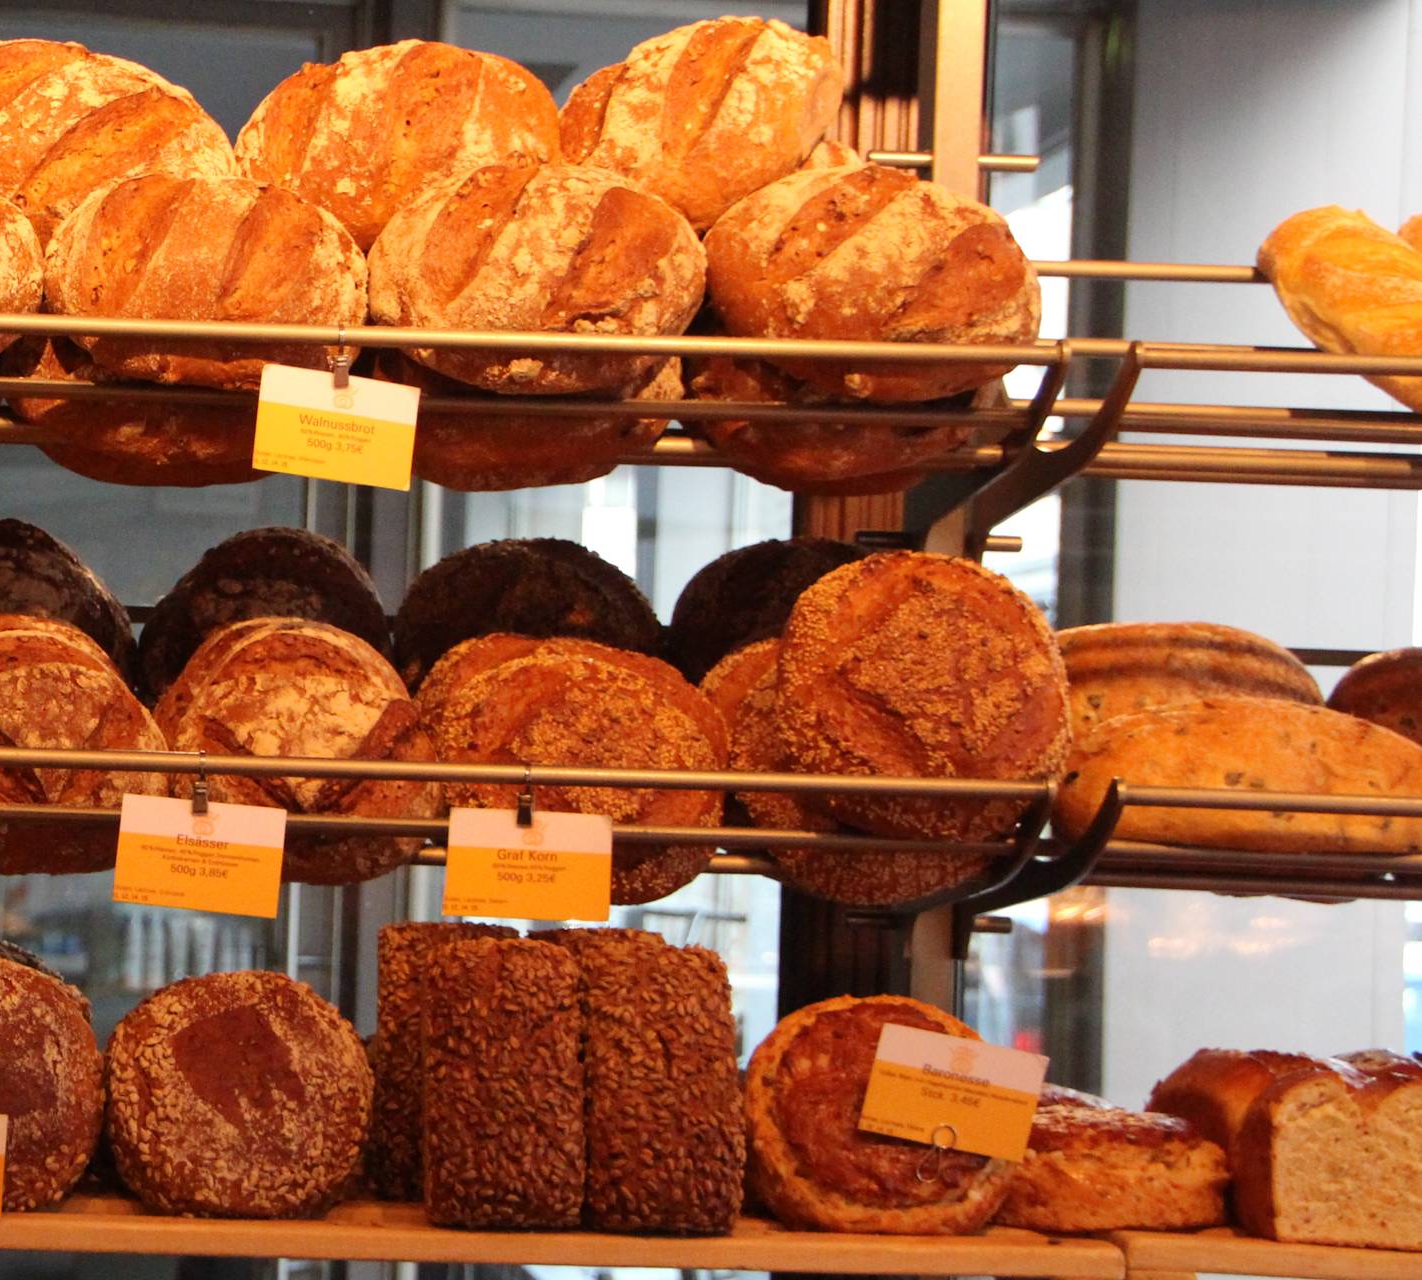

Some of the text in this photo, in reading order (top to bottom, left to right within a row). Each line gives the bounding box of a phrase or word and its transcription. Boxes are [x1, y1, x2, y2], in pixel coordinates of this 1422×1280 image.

[298, 413, 376, 435] Walnussbrot
[306, 438, 364, 455] 500g 3,75€
[175, 833, 229, 850] Elsässer
[497, 849, 558, 862] Graf Korn
[170, 863, 229, 879] 500g 3,85€
[497, 871, 523, 884] 500g
[922, 1063, 991, 1087] Baronesse
